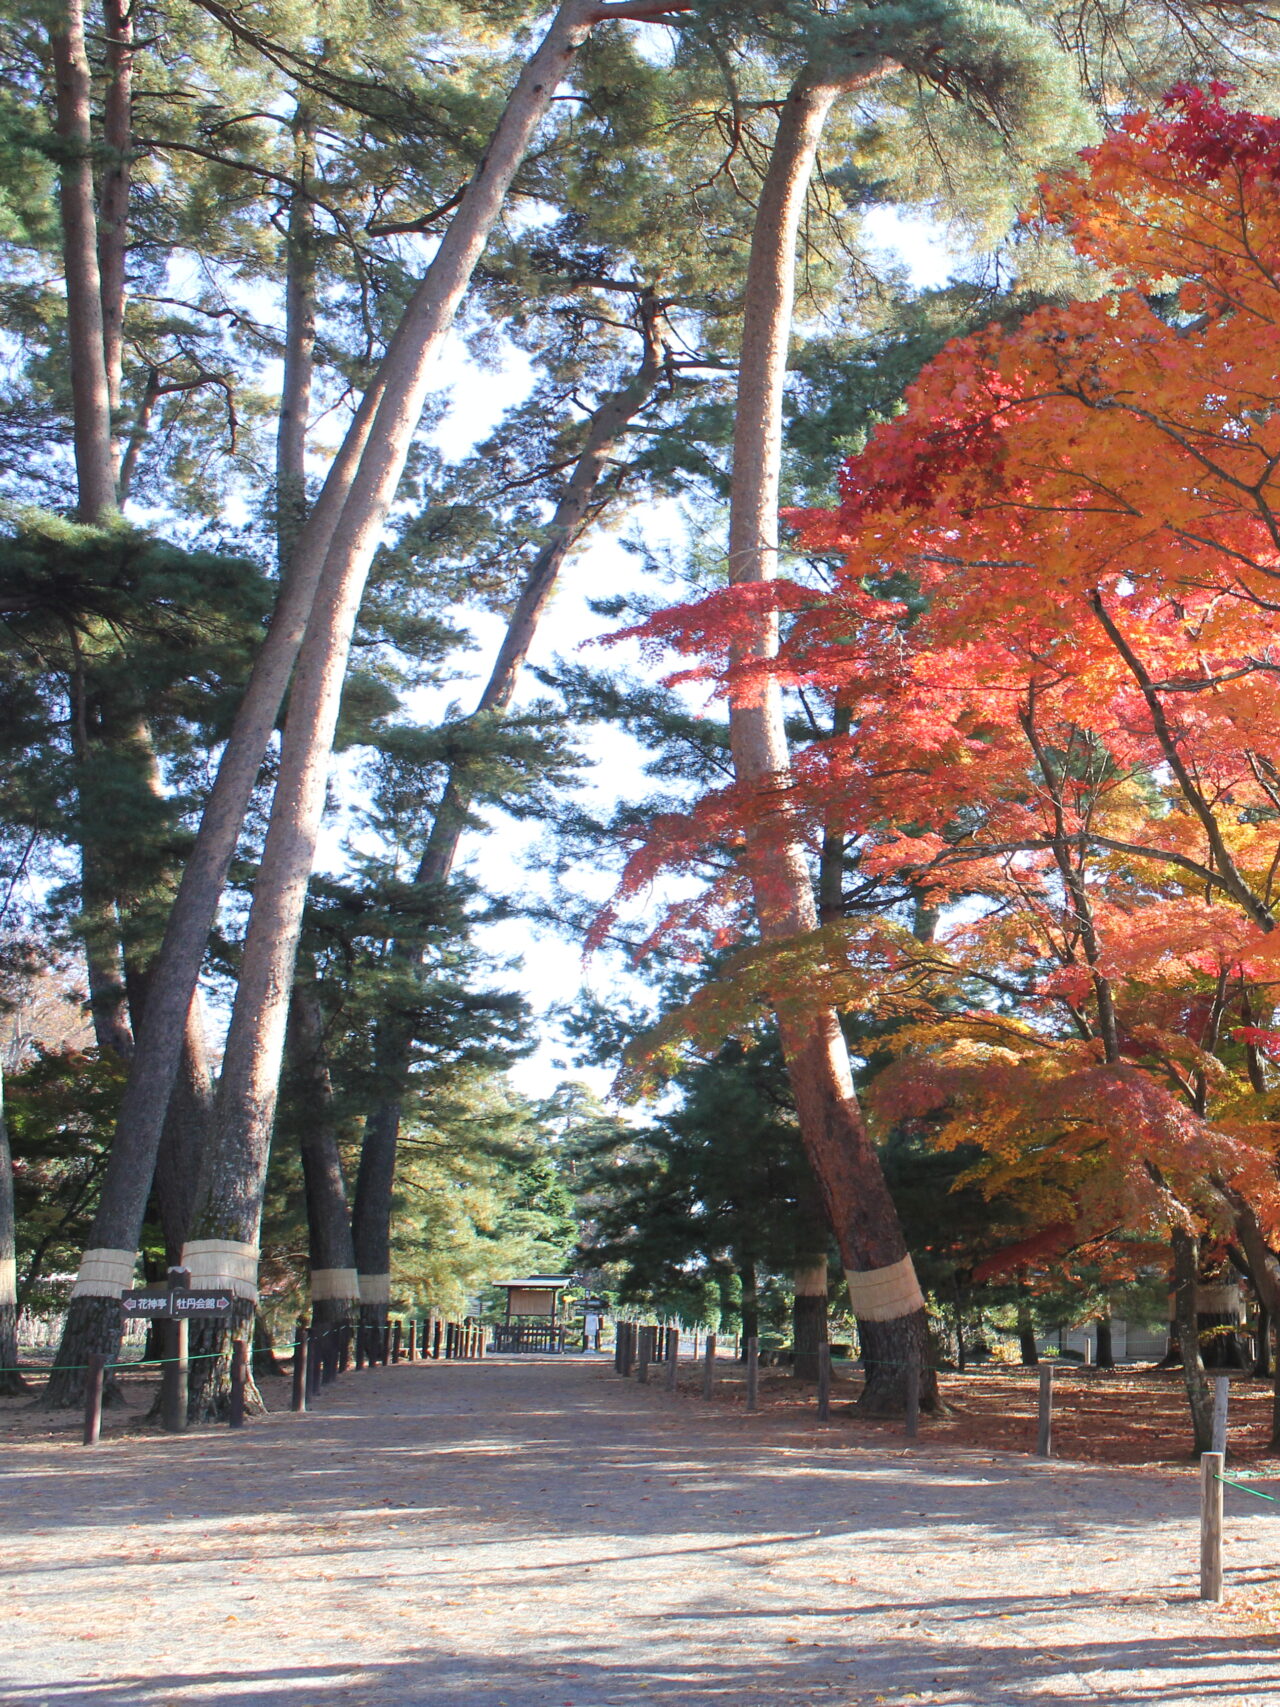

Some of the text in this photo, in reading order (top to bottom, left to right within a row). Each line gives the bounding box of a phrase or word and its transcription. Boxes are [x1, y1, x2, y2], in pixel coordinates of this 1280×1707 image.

[138, 1298, 167, 1309] 花神亭
[176, 1298, 216, 1309] 牡丹会館
